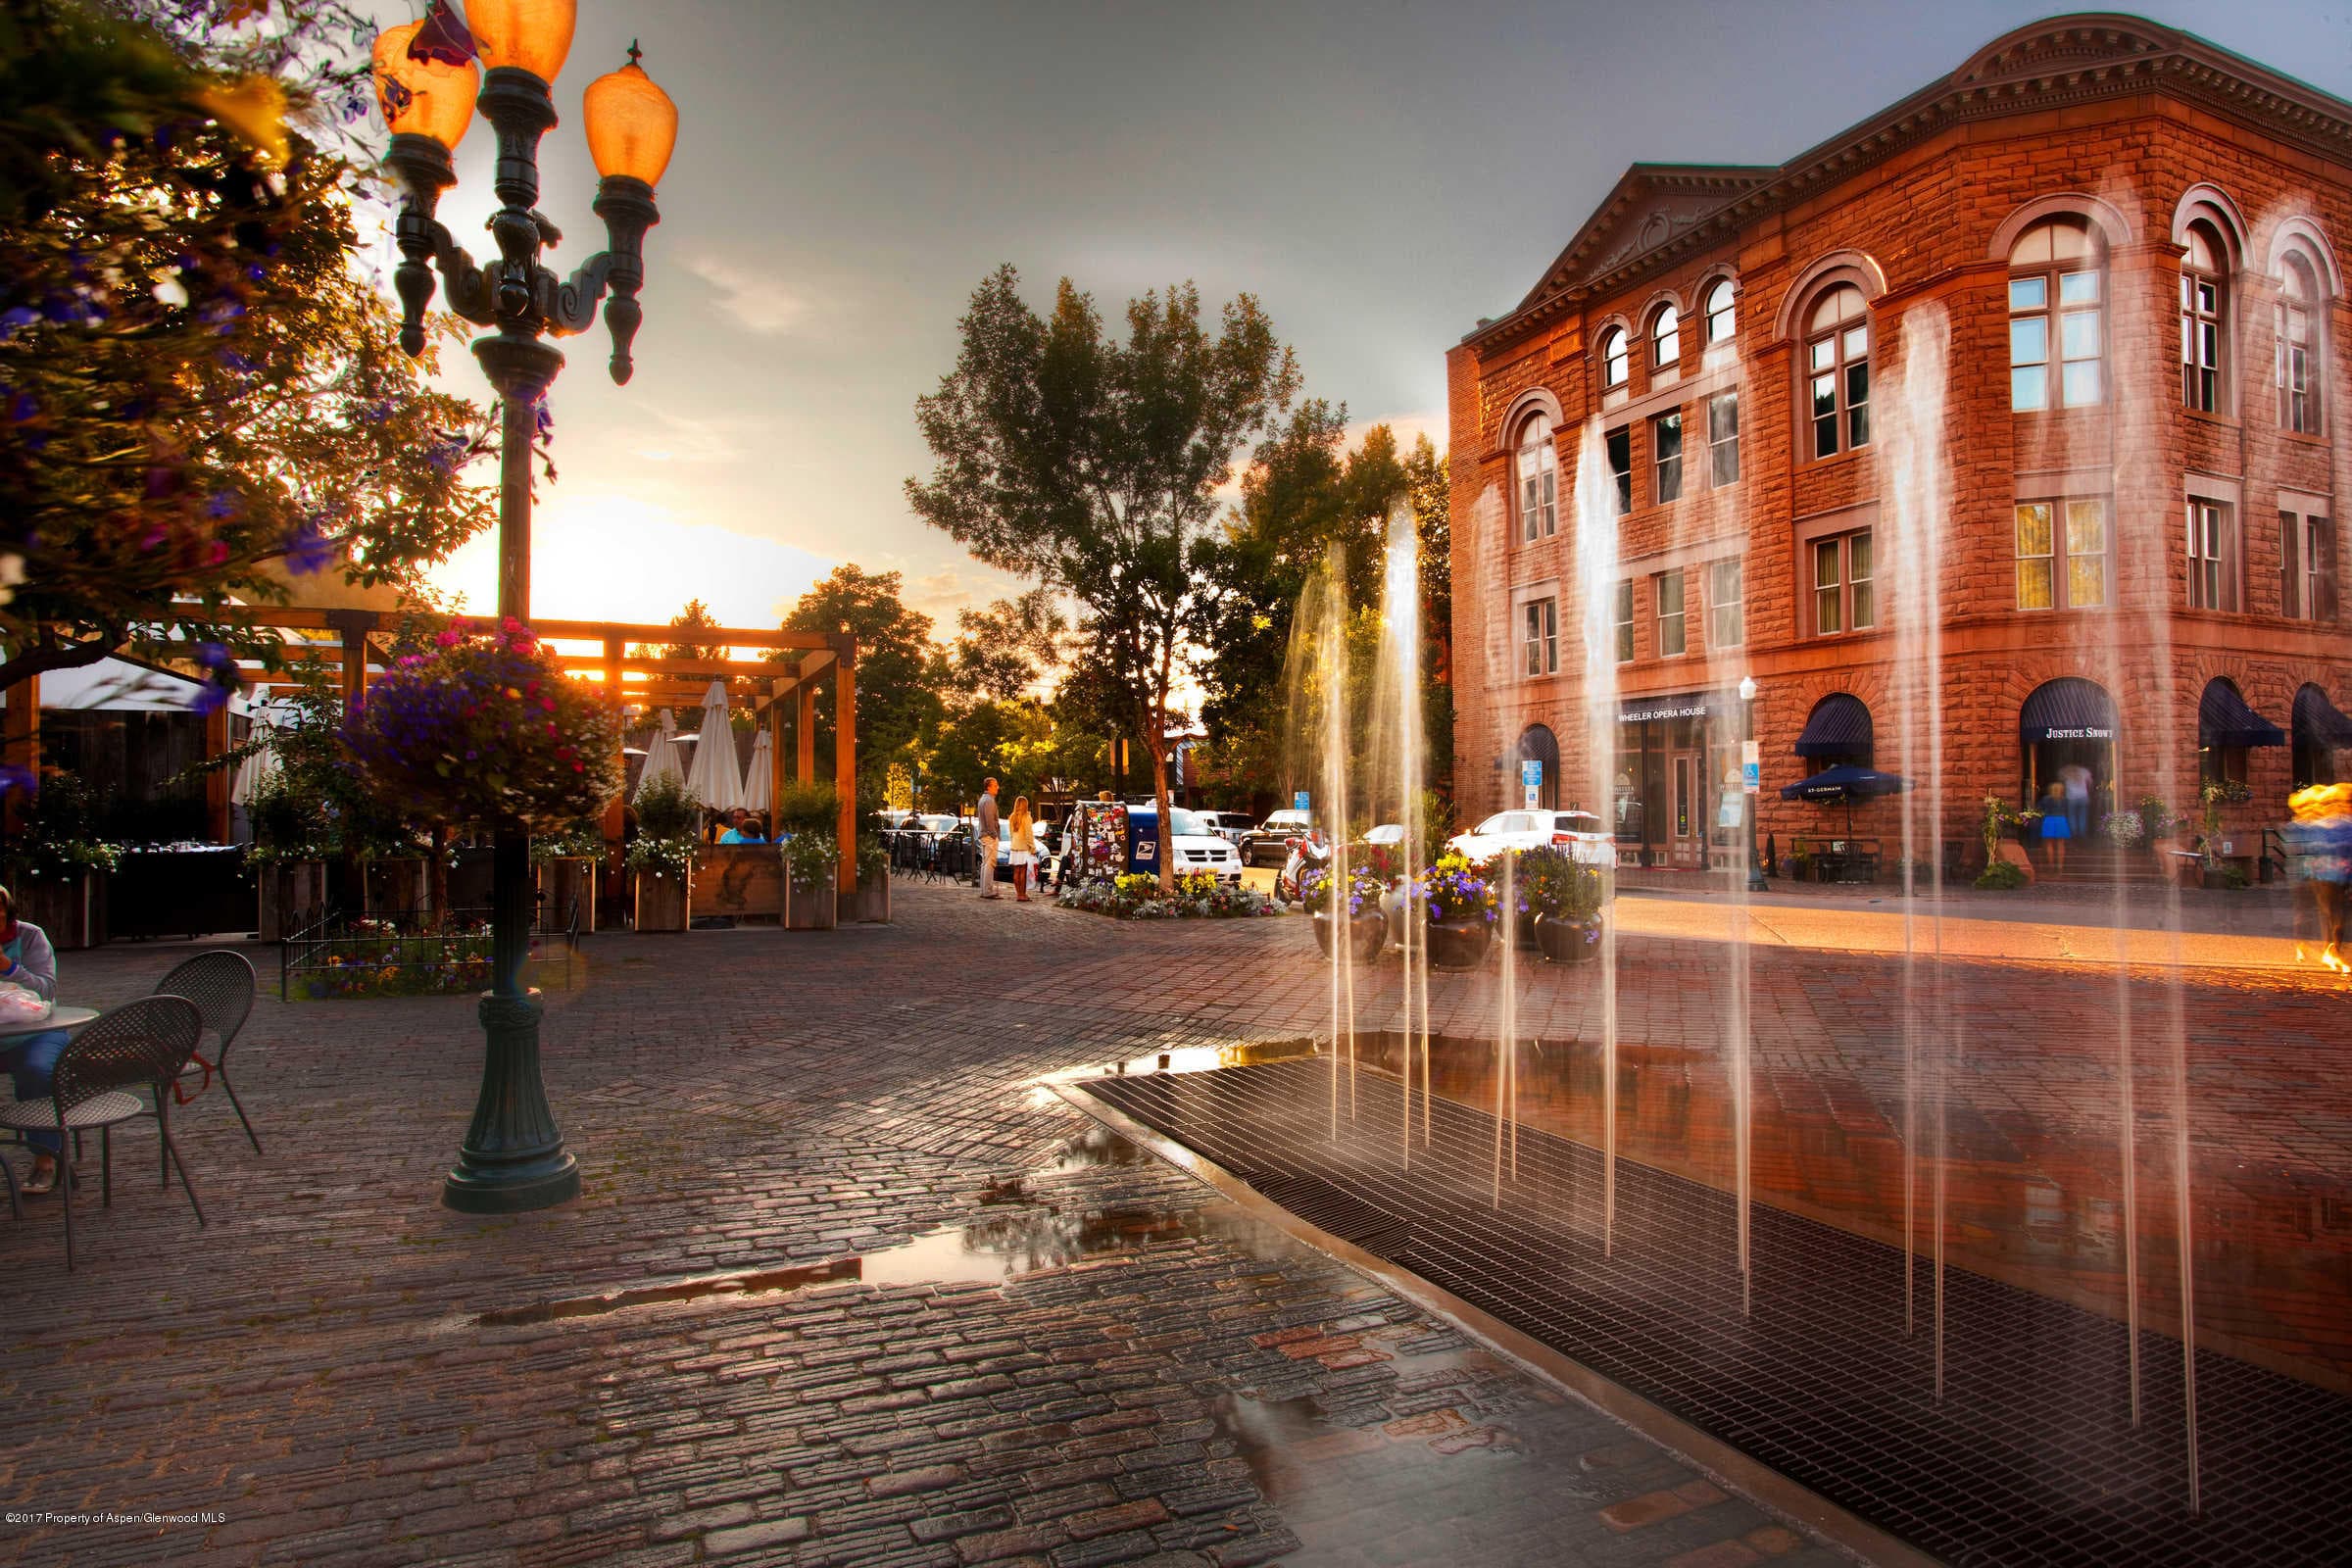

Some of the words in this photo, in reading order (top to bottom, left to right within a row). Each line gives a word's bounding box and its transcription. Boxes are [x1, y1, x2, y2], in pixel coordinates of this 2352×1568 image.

[1618, 711, 1652, 722] WHEELER
[1653, 710, 1678, 719] OPERA
[1680, 707, 1706, 716] HOUSE
[2046, 728, 2084, 738] JUSTICE
